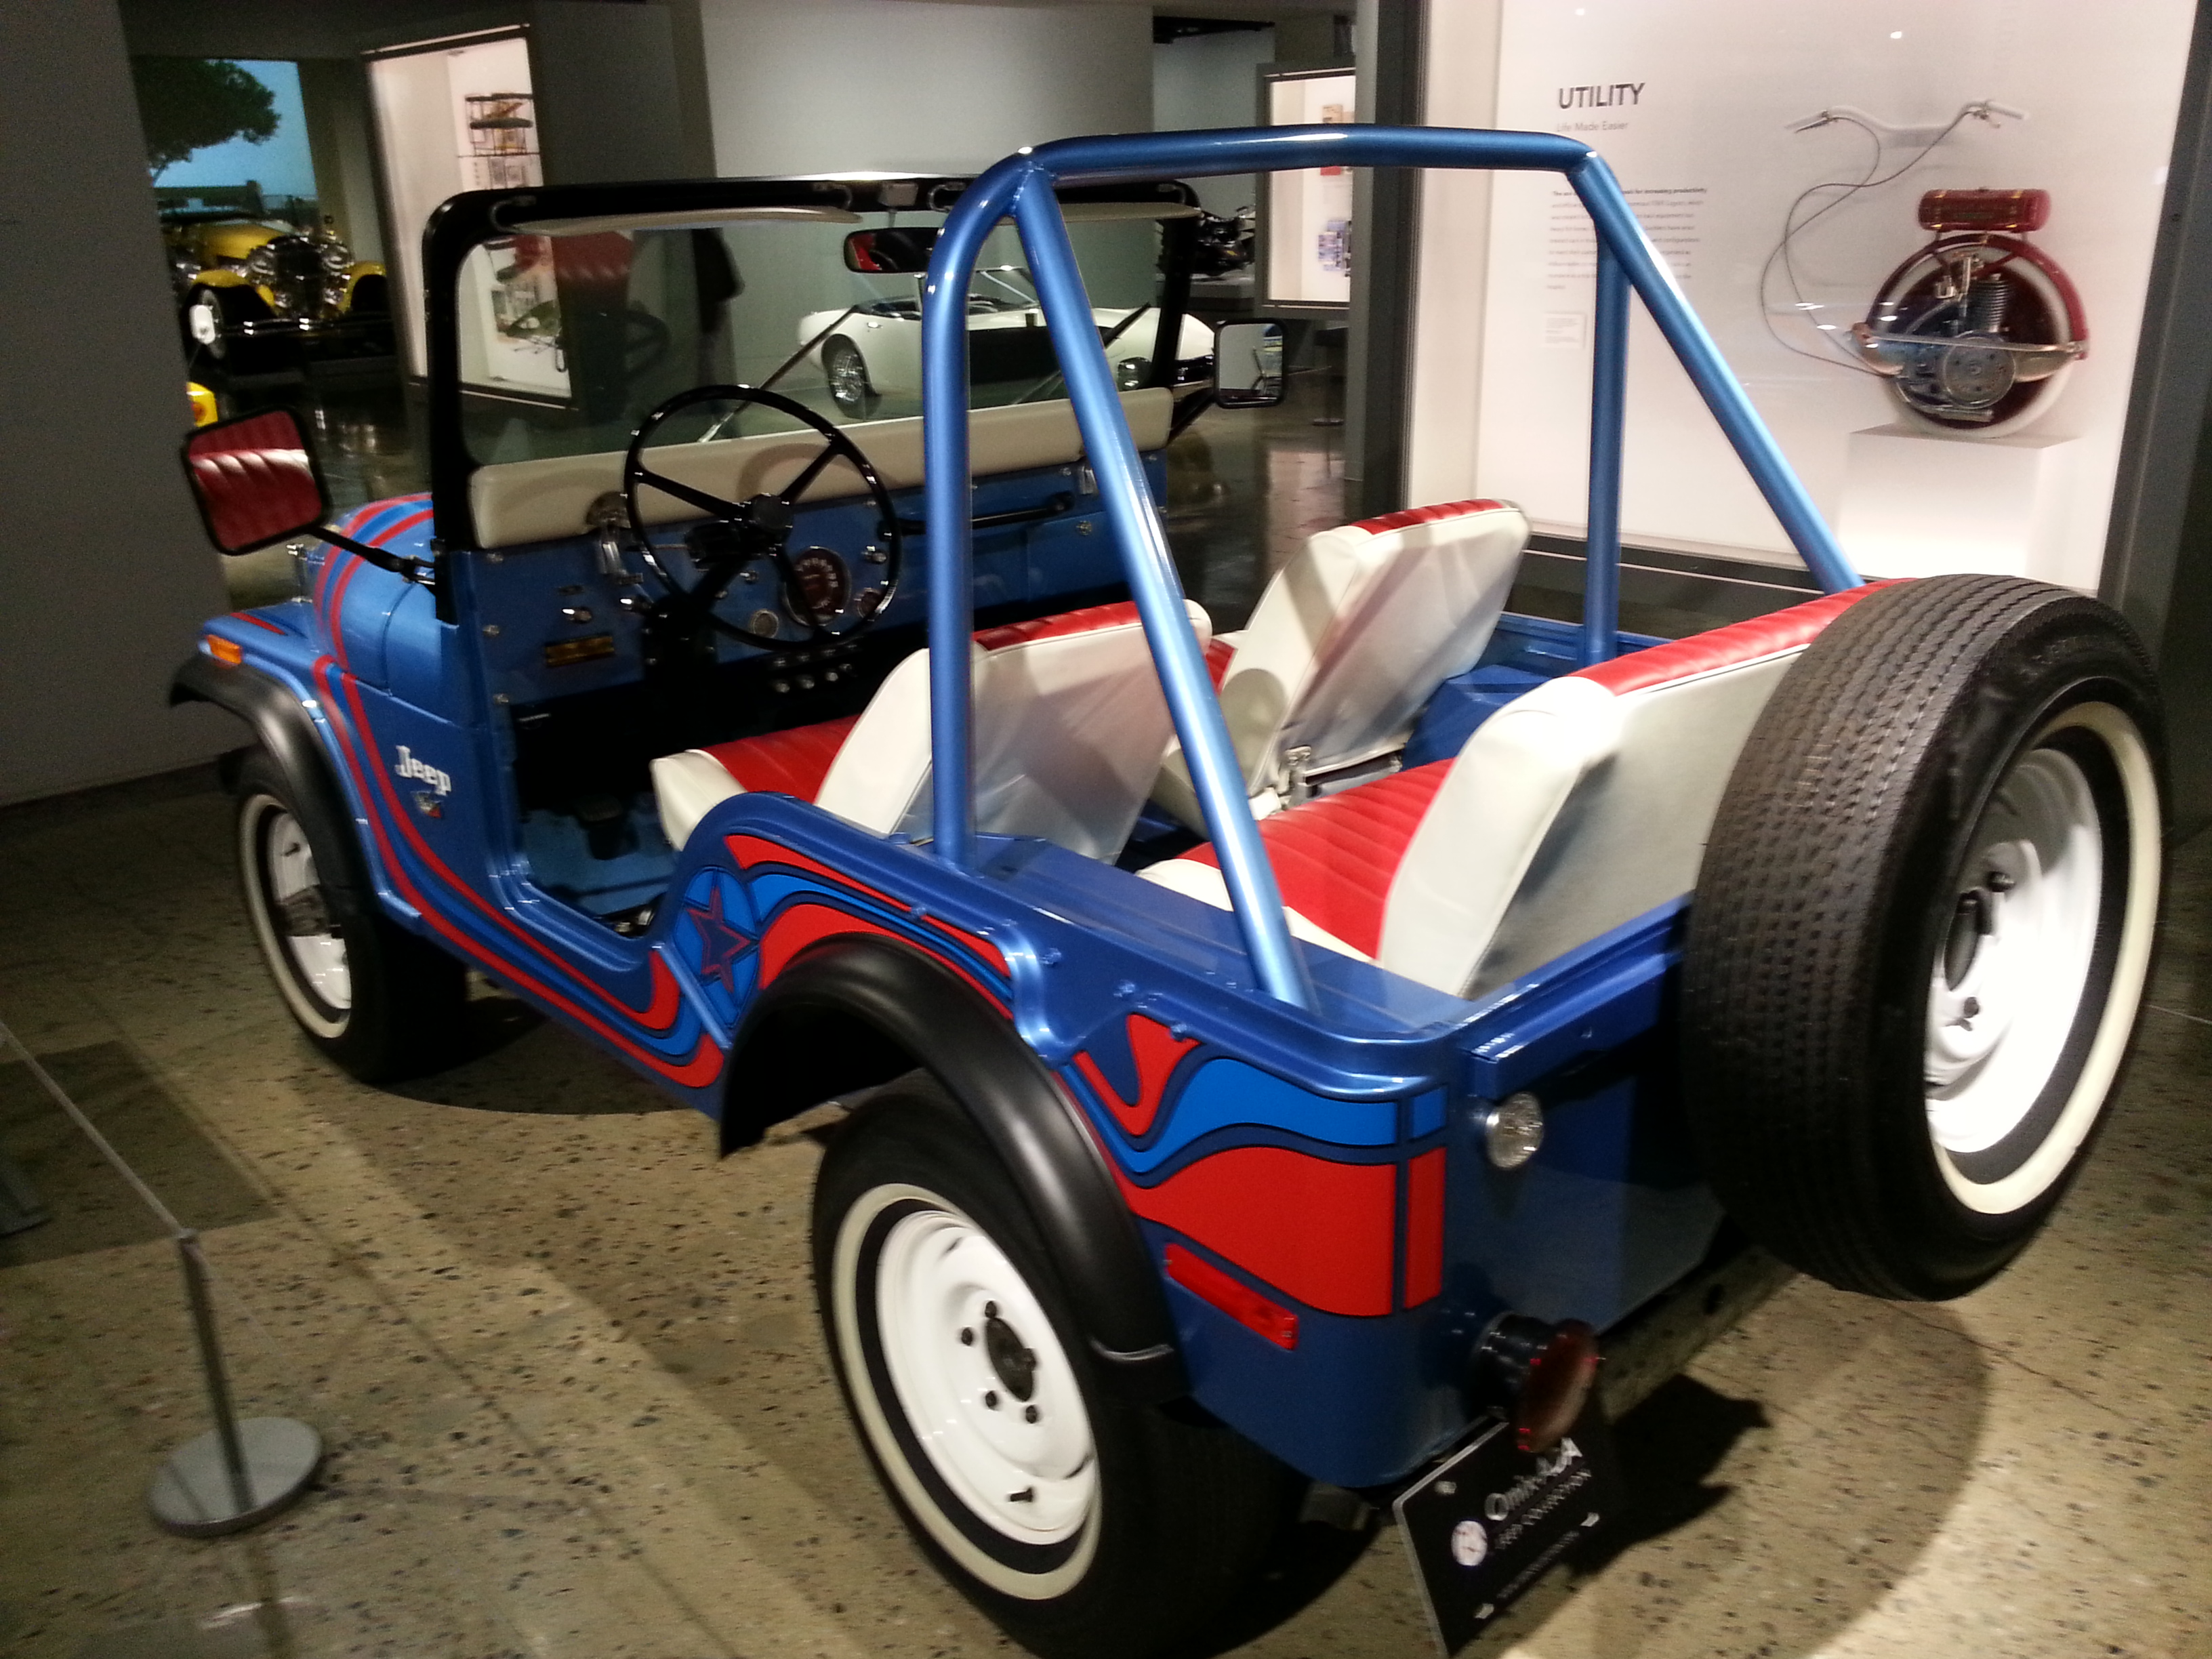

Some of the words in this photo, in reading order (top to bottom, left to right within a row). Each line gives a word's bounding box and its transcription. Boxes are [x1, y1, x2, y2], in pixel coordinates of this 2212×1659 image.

[1558, 82, 1646, 110] UTILITY
[1557, 122, 1571, 132] Life
[1574, 121, 1600, 131] Made
[1602, 121, 1629, 131] Easier
[394, 745, 452, 796] Jeep
